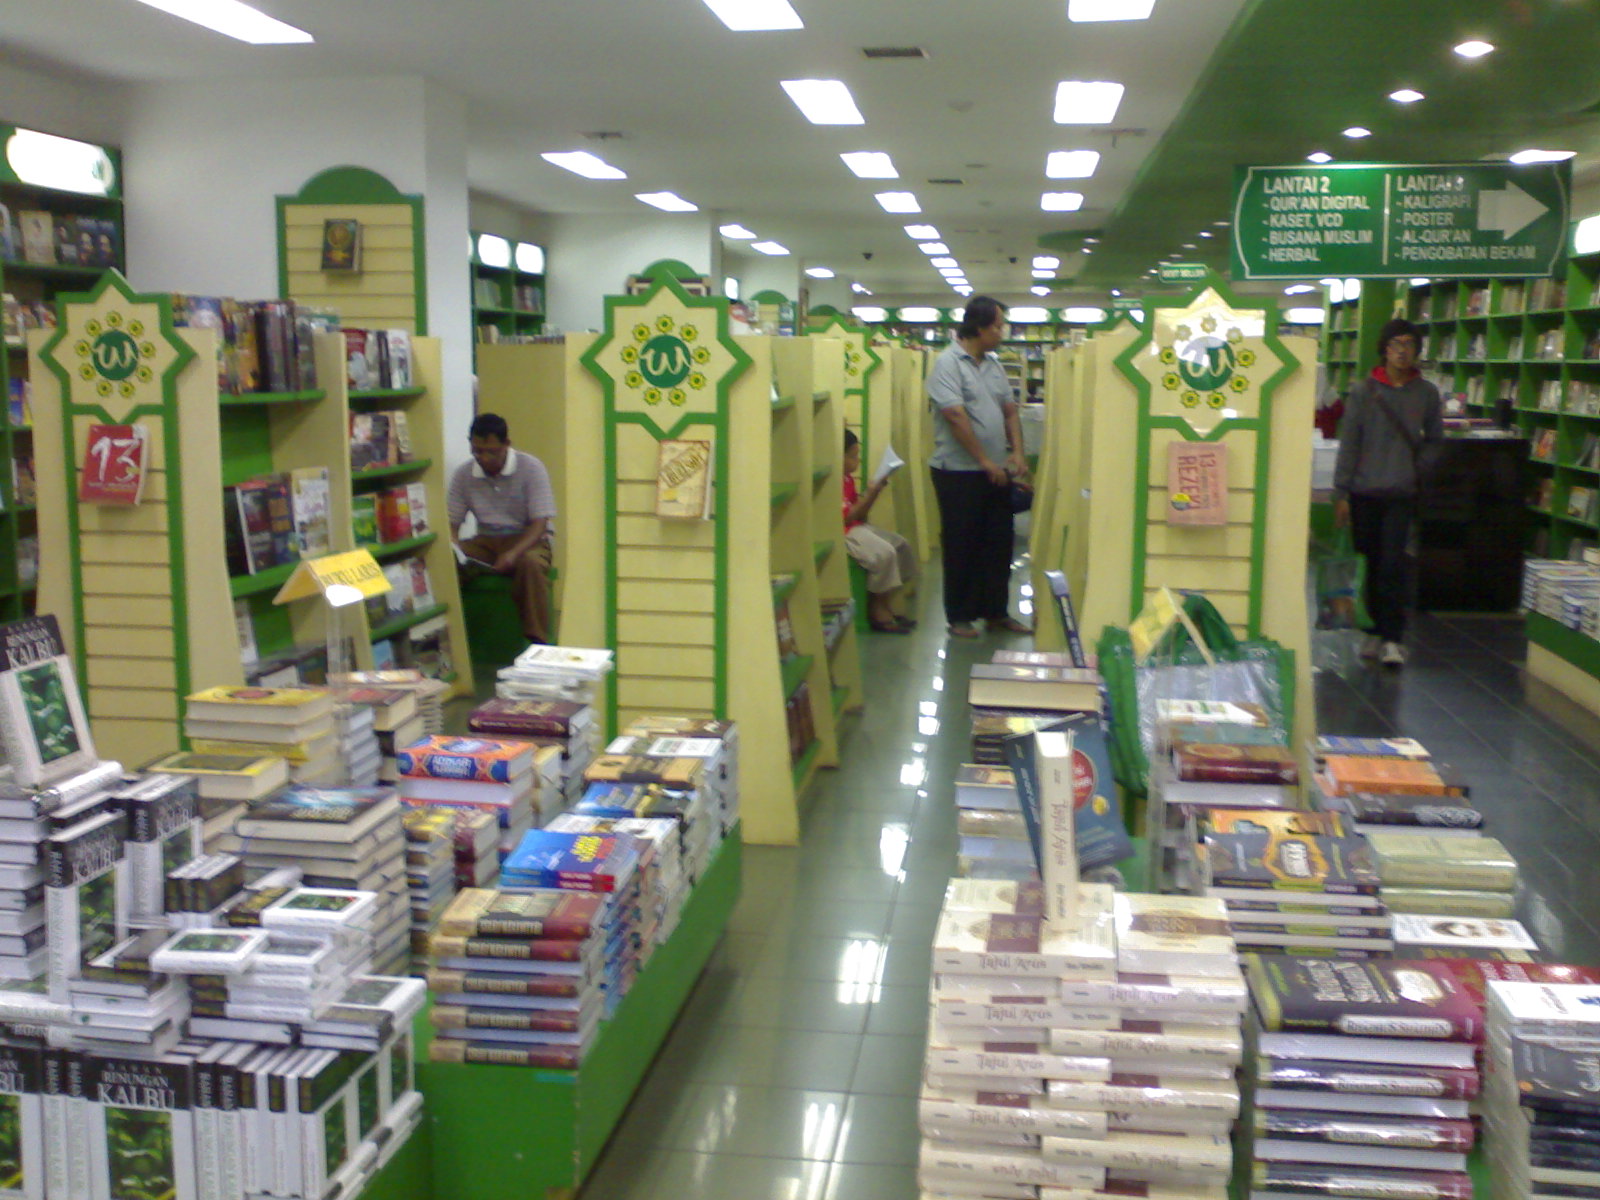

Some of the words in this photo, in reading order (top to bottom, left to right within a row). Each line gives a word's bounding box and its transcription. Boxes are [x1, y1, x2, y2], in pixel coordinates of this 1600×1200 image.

[1263, 176, 1318, 193] LANTAI
[1320, 176, 1330, 193] 2
[1321, 195, 1371, 210] DIGITAL
[1316, 213, 1344, 227] VCD
[1403, 212, 1454, 226] POSTER
[1269, 230, 1322, 245] BUSANA
[1323, 230, 1374, 244] MUSLIM
[1268, 247, 1321, 262] HERBAL
[1401, 246, 1488, 260] PENGOBATAN
[91, 436, 139, 482] 13
[978, 953, 1011, 970] Tajul
[97, 1082, 176, 1109] KALBU
